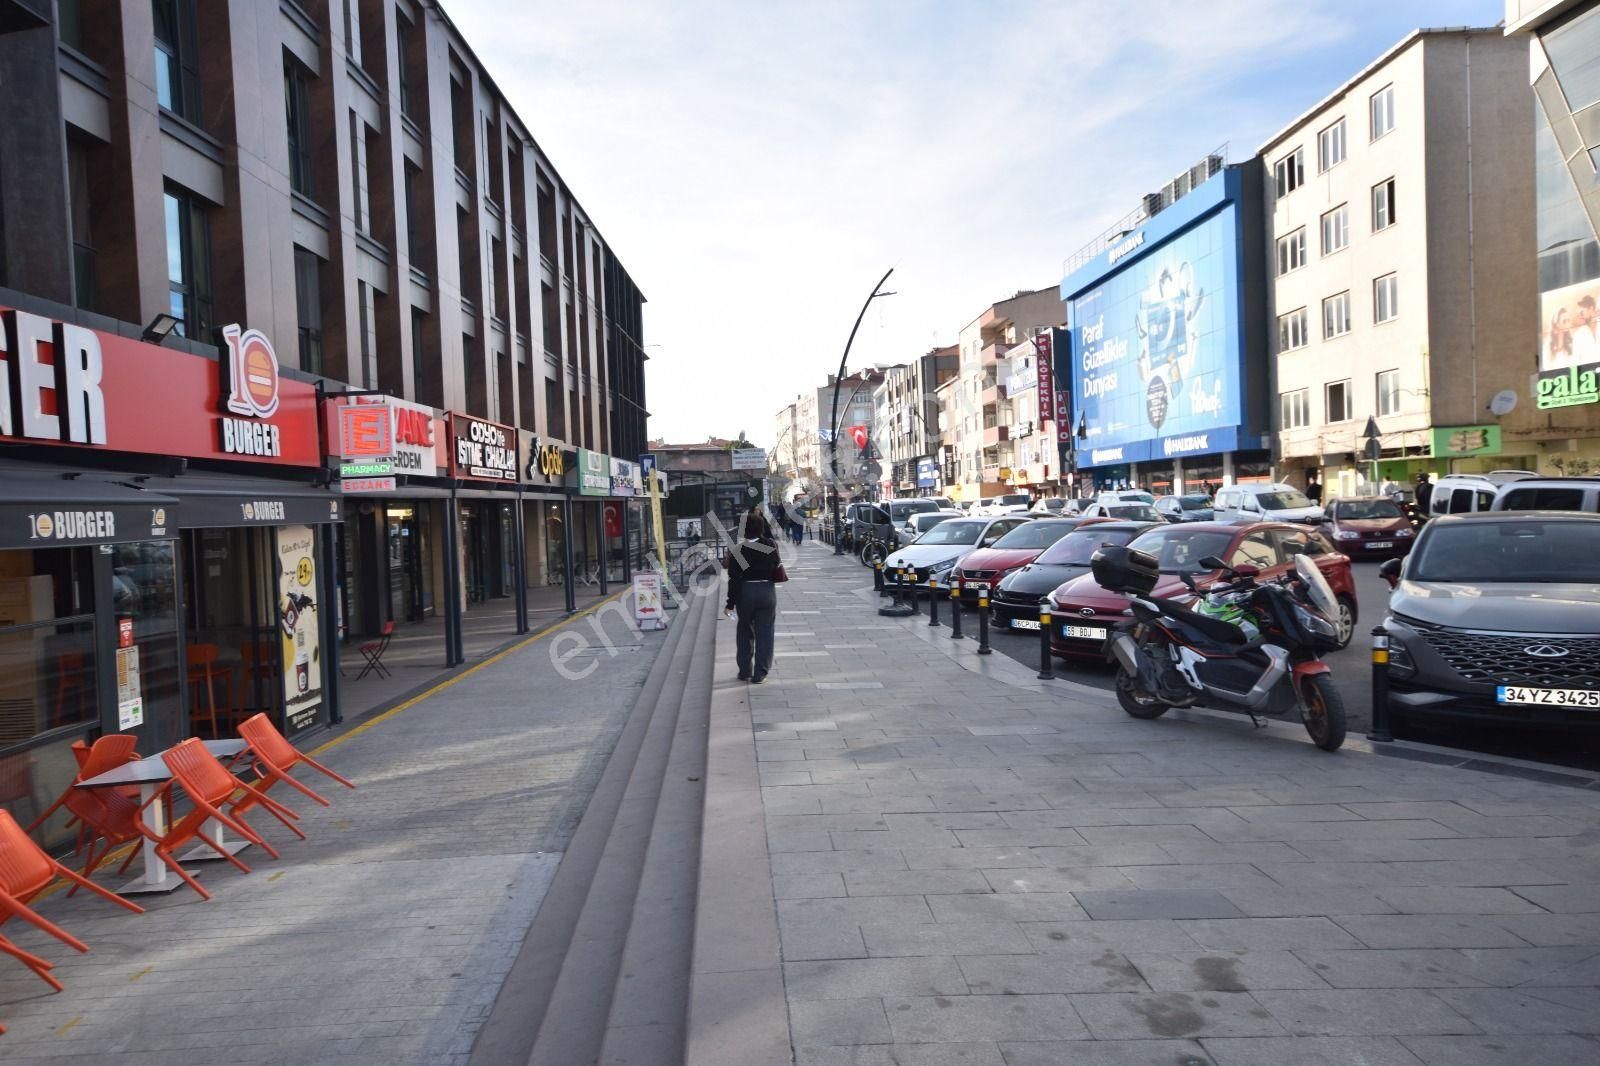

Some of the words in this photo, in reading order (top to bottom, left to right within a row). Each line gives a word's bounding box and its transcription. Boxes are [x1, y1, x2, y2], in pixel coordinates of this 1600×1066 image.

[0, 309, 107, 445] ER
[1536, 366, 1598, 409] gala
[223, 418, 281, 457] BURGER
[470, 421, 497, 446] ODYO
[342, 464, 391, 475] PHARMACY
[344, 480, 391, 490] ECZANE
[253, 501, 285, 520] BURGER
[54, 511, 115, 539] BURGER
[1506, 688, 1526, 701] 34
[1529, 689, 1552, 703] YZ
[1556, 690, 1599, 704] 3425
